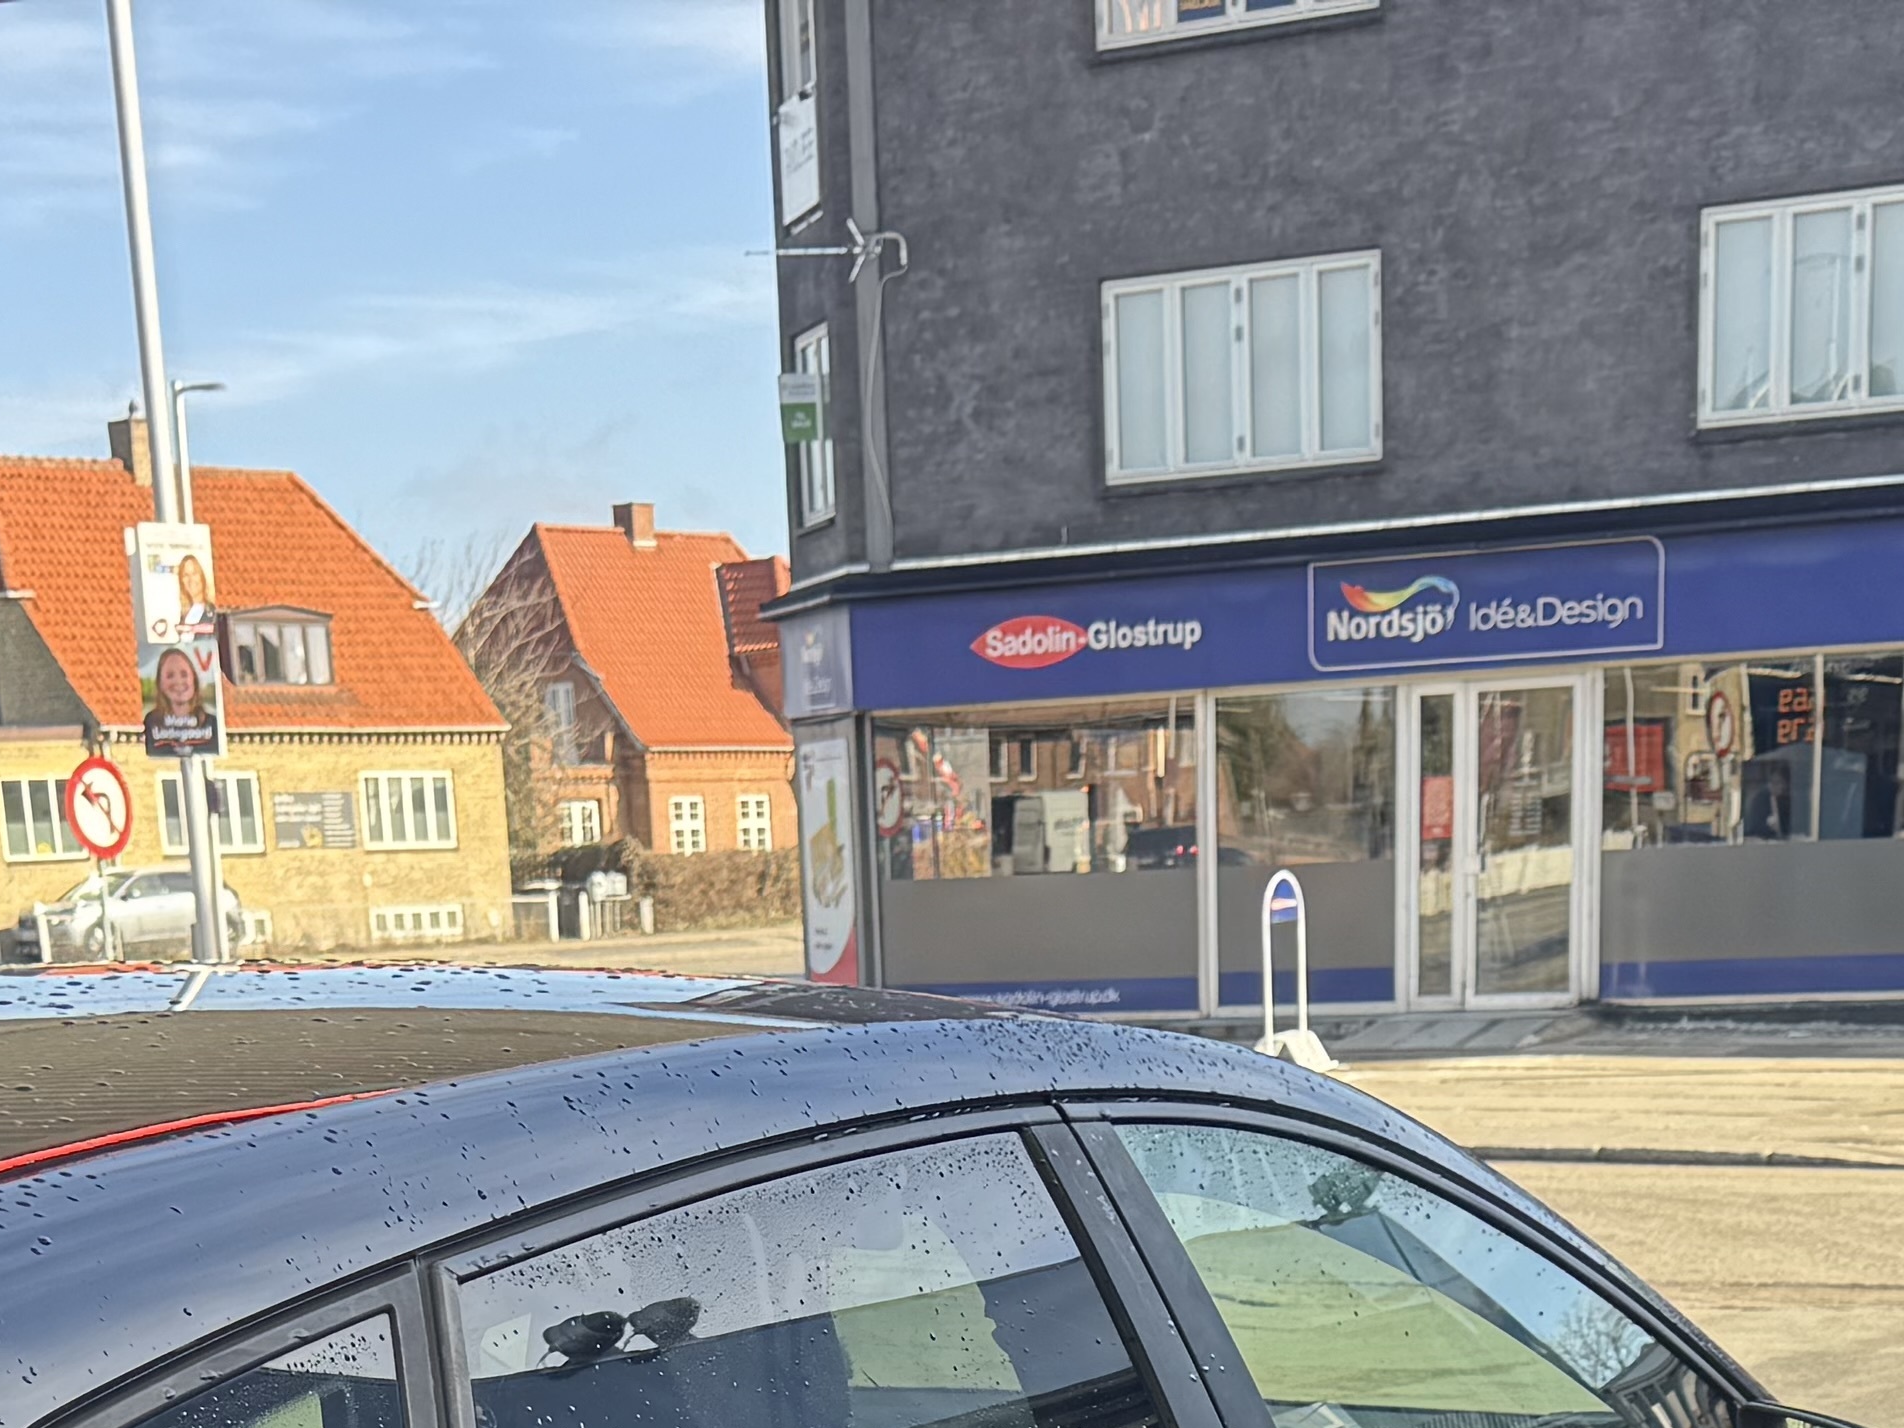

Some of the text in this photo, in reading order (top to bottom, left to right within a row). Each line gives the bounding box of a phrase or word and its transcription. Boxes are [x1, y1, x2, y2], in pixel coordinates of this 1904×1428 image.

[985, 618, 1202, 658] Sadolin-Glostrup
[1326, 592, 1644, 643] Nordsjö Idé&Design
